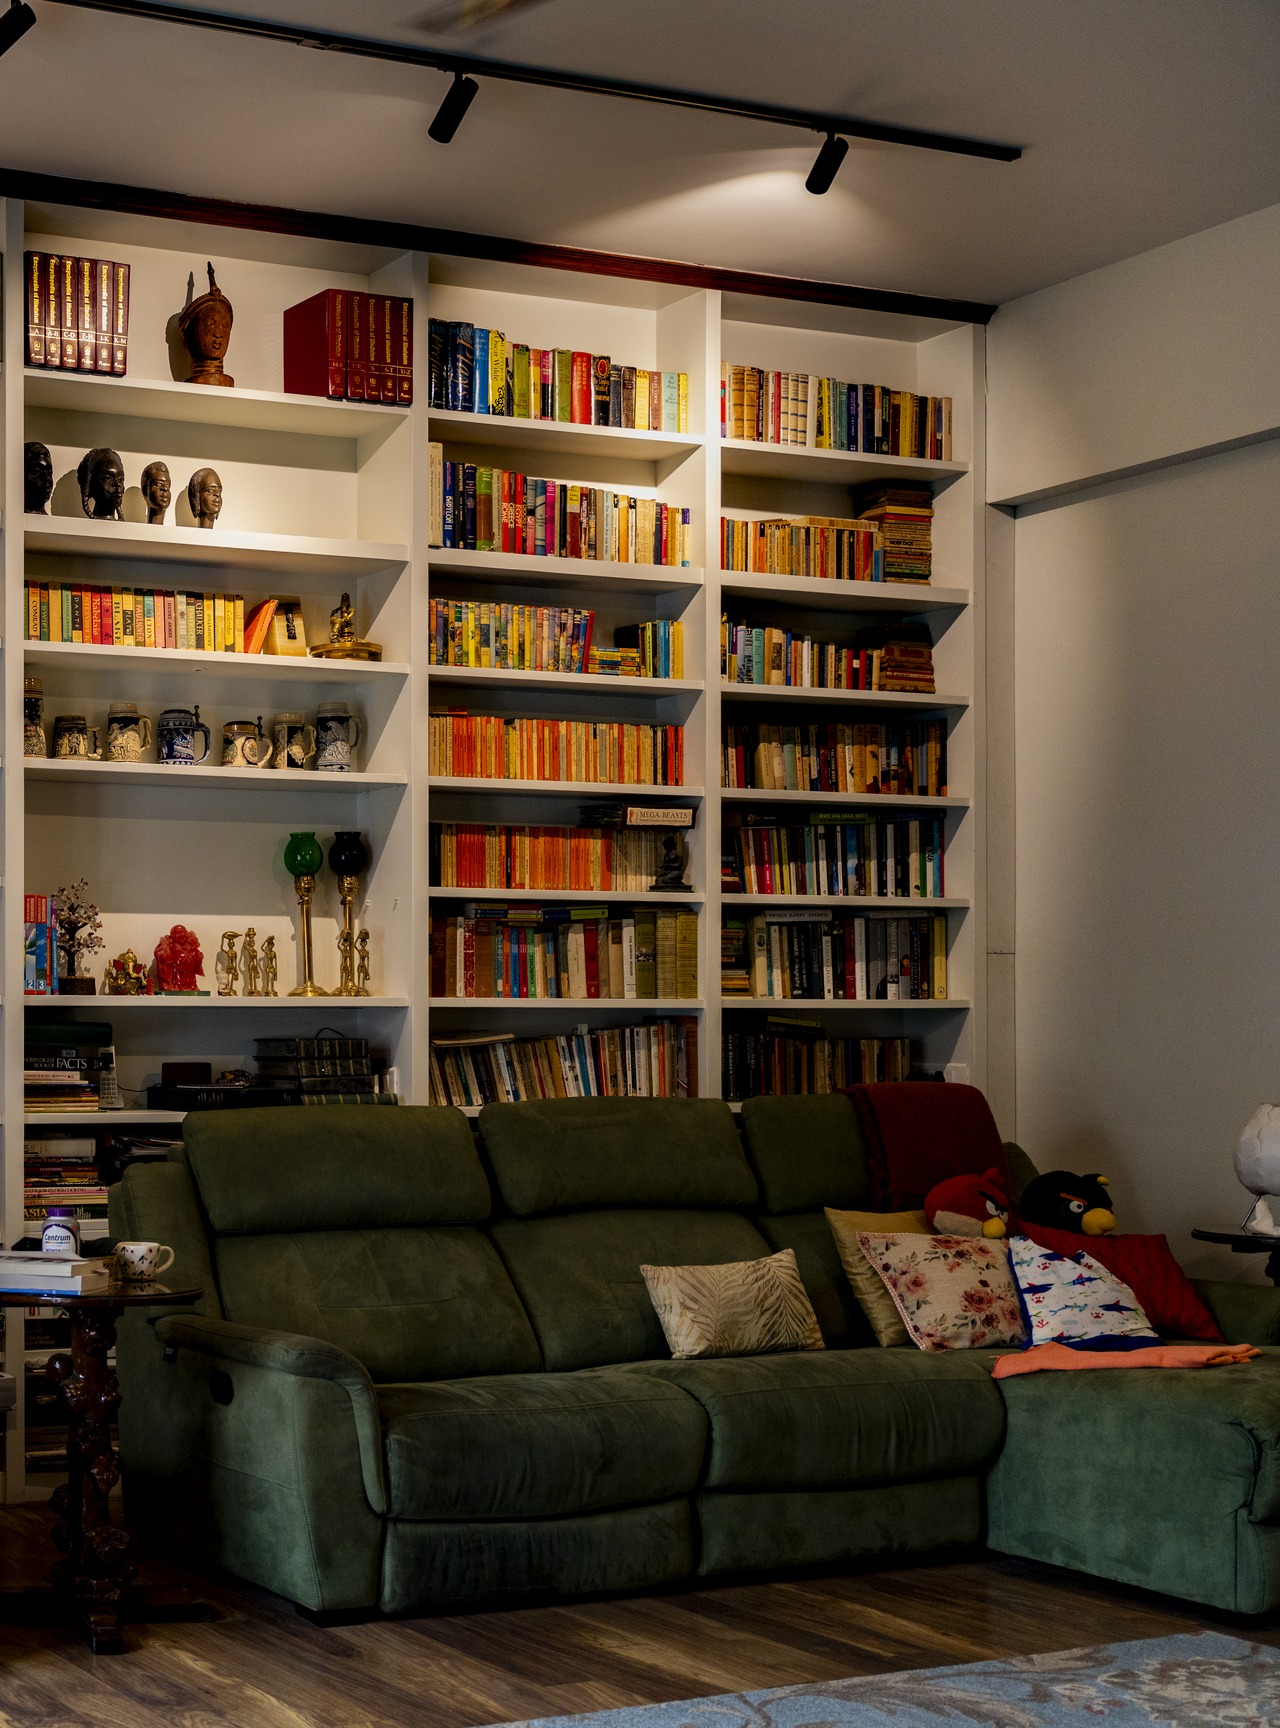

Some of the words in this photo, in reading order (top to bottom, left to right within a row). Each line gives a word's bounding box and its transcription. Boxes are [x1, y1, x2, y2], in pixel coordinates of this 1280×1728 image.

[92, 597, 100, 636] Rabelais
[639, 811, 688, 819] MEGA-BEASTS
[28, 980, 34, 989] 2
[38, 980, 45, 989] 3
[56, 1058, 88, 1069] FACTS
[44, 1233, 71, 1241] Centrum
